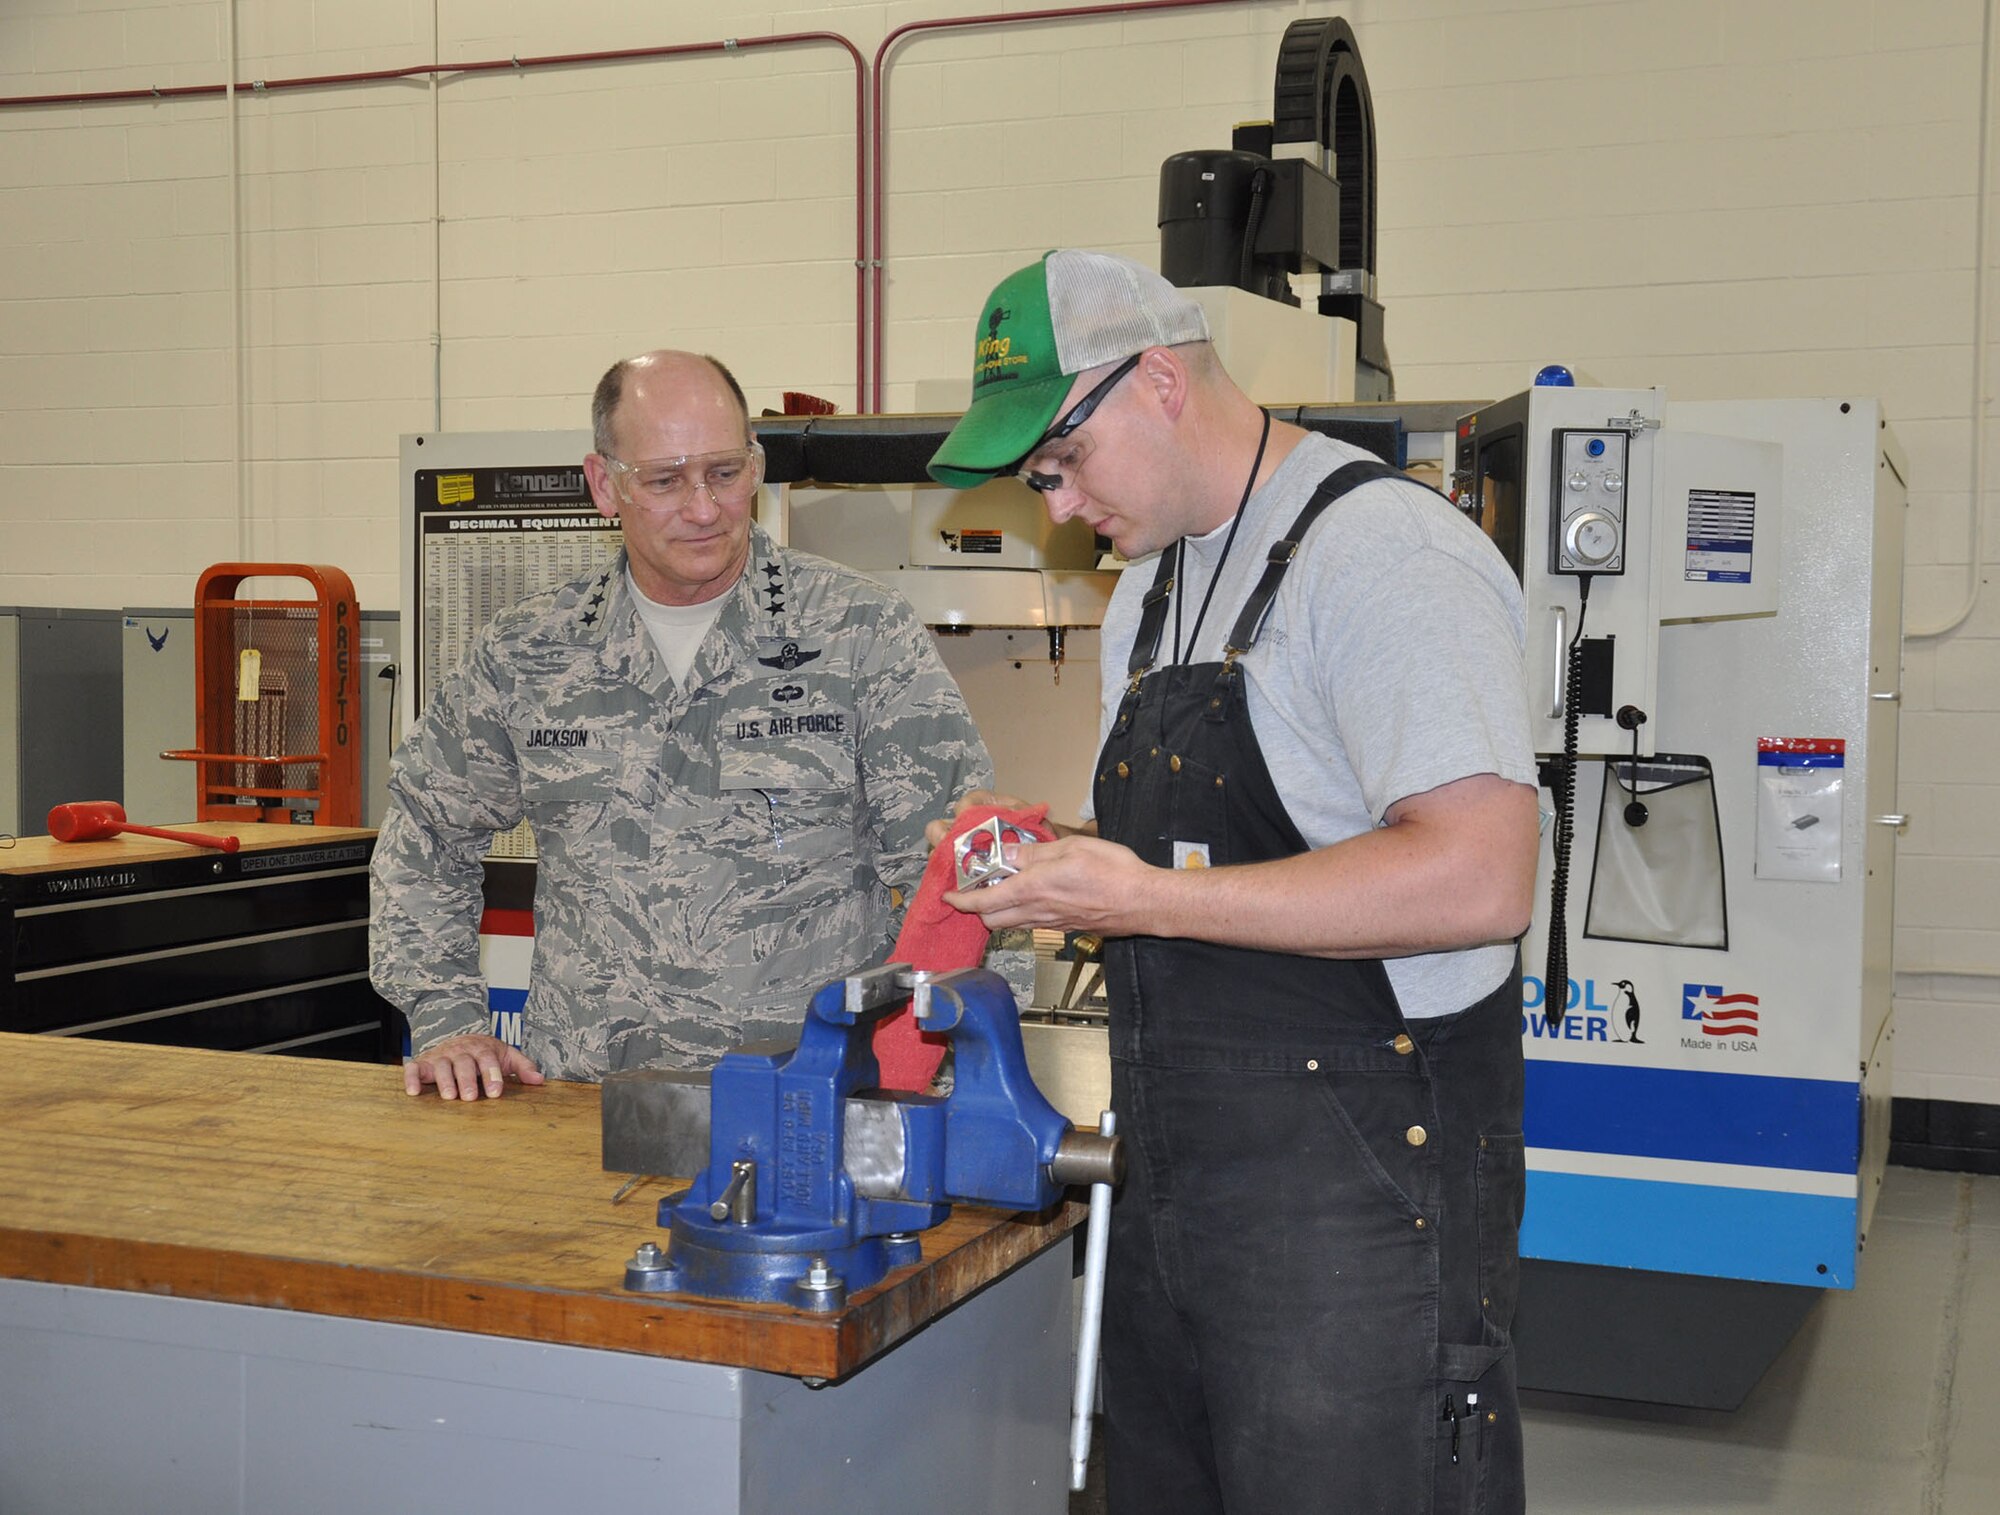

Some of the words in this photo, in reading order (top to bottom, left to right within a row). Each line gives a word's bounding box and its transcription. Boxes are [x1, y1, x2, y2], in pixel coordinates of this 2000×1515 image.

[977, 336, 1010, 357] King
[495, 470, 584, 497] Kennedy
[449, 519, 518, 530] DECIMAL
[336, 600, 348, 746] PRESTO
[526, 729, 588, 748] JACKSON
[736, 721, 764, 740] U.S.
[769, 717, 793, 736] AIR
[797, 714, 844, 733] FORCE
[243, 859, 267, 870] OPEN
[269, 855, 288, 866] ONE
[289, 851, 325, 865] DRAWER
[327, 850, 337, 861] AT
[346, 847, 365, 858] TIME
[1521, 1013, 1608, 1042] WER
[1680, 1038, 1712, 1049] Made
[1717, 1040, 1727, 1050] in
[1732, 1041, 1758, 1052] USA
